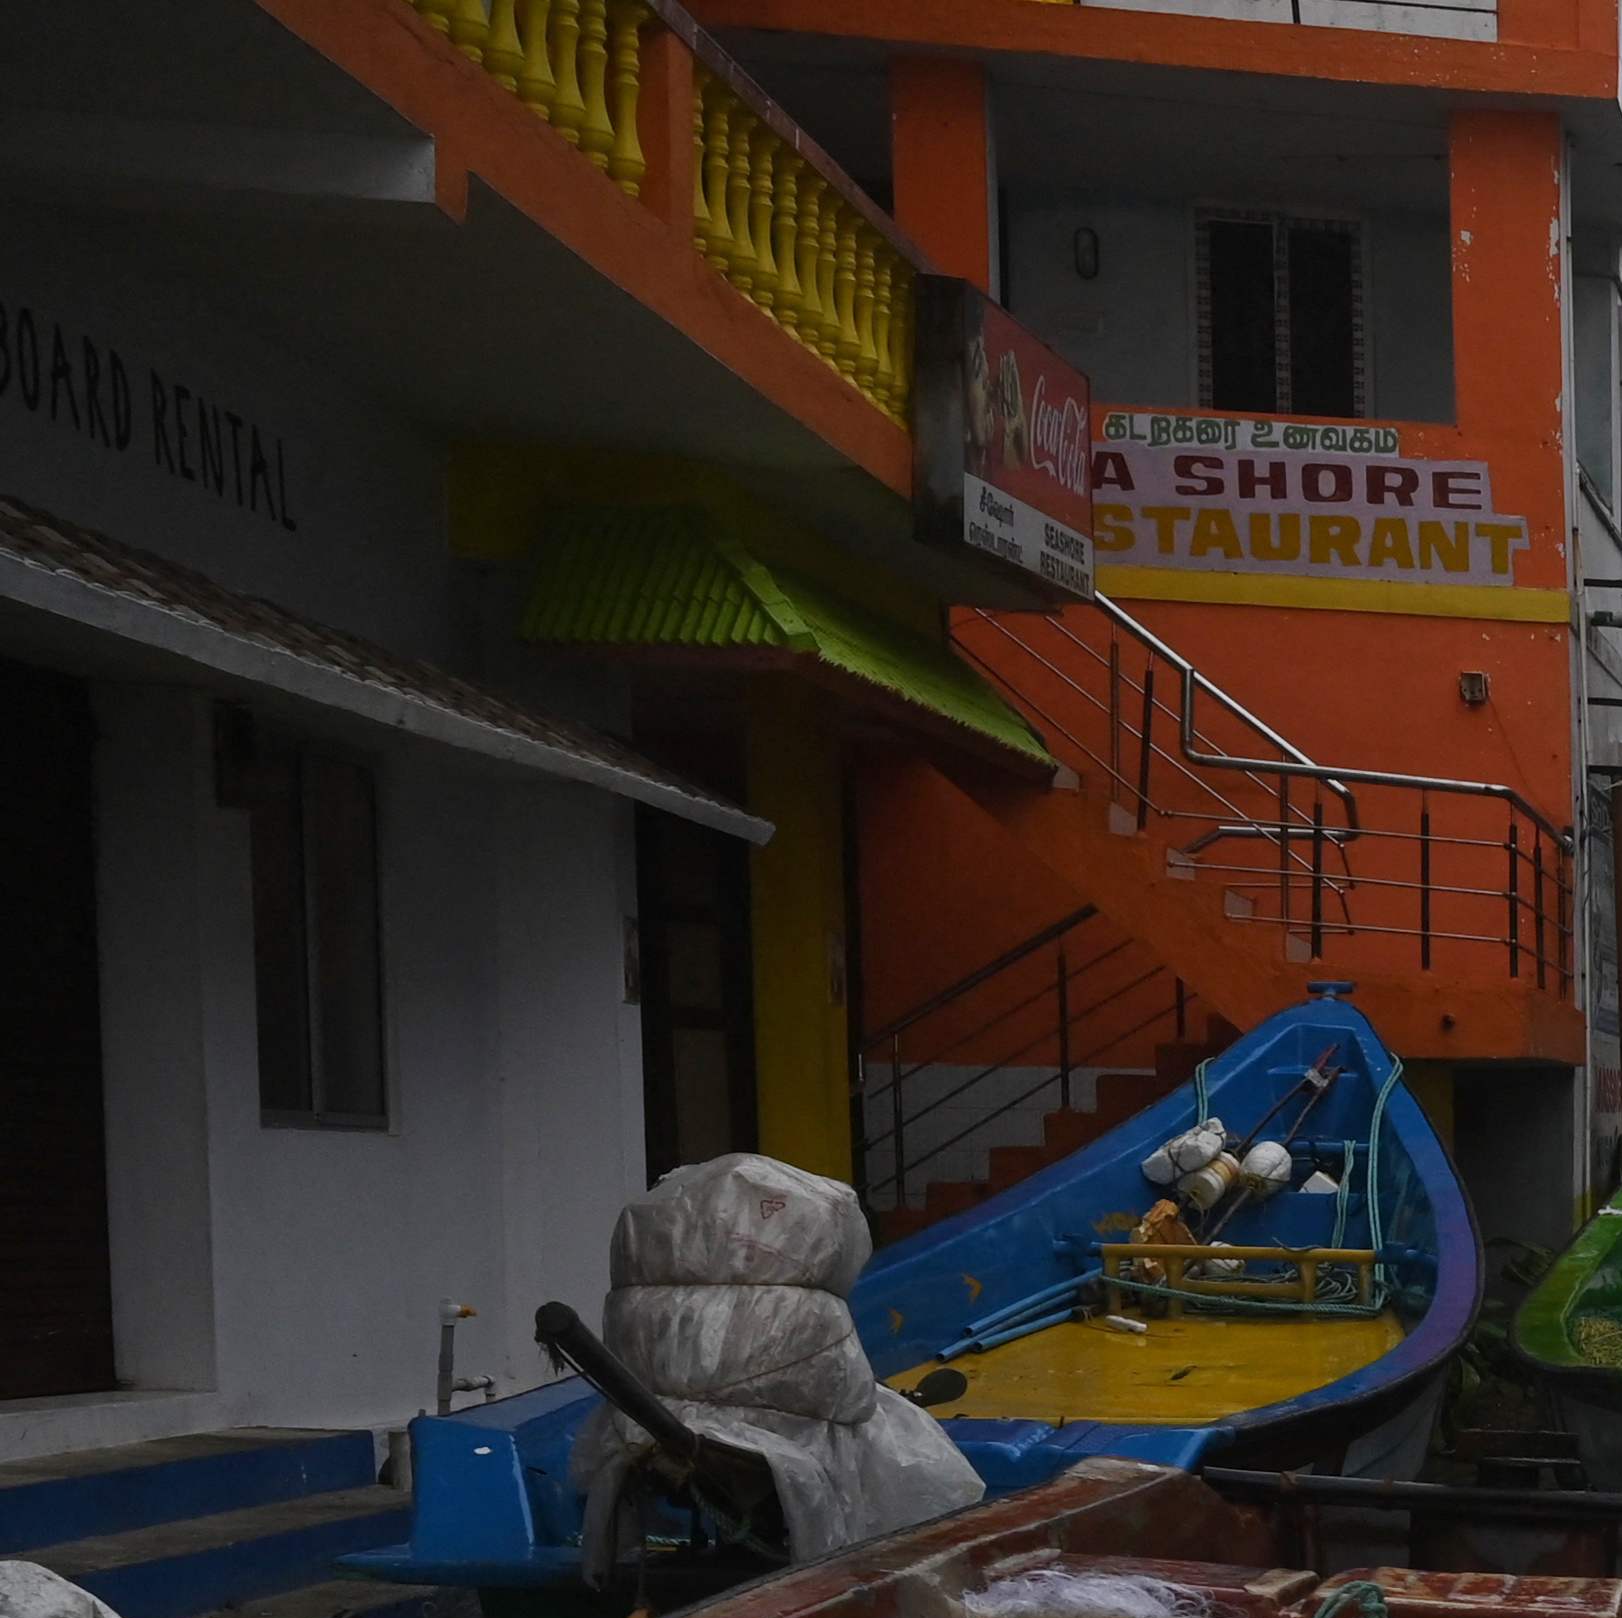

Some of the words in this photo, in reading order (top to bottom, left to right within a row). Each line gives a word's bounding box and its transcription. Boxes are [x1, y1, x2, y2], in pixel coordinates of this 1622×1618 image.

[149, 367, 297, 532] RENTAL
[1029, 374, 1088, 497] Coca-Cola
[1173, 454, 1483, 511] SHORE
[1044, 523, 1085, 565] SEASHORE
[1039, 550, 1090, 596] RESTAURANT
